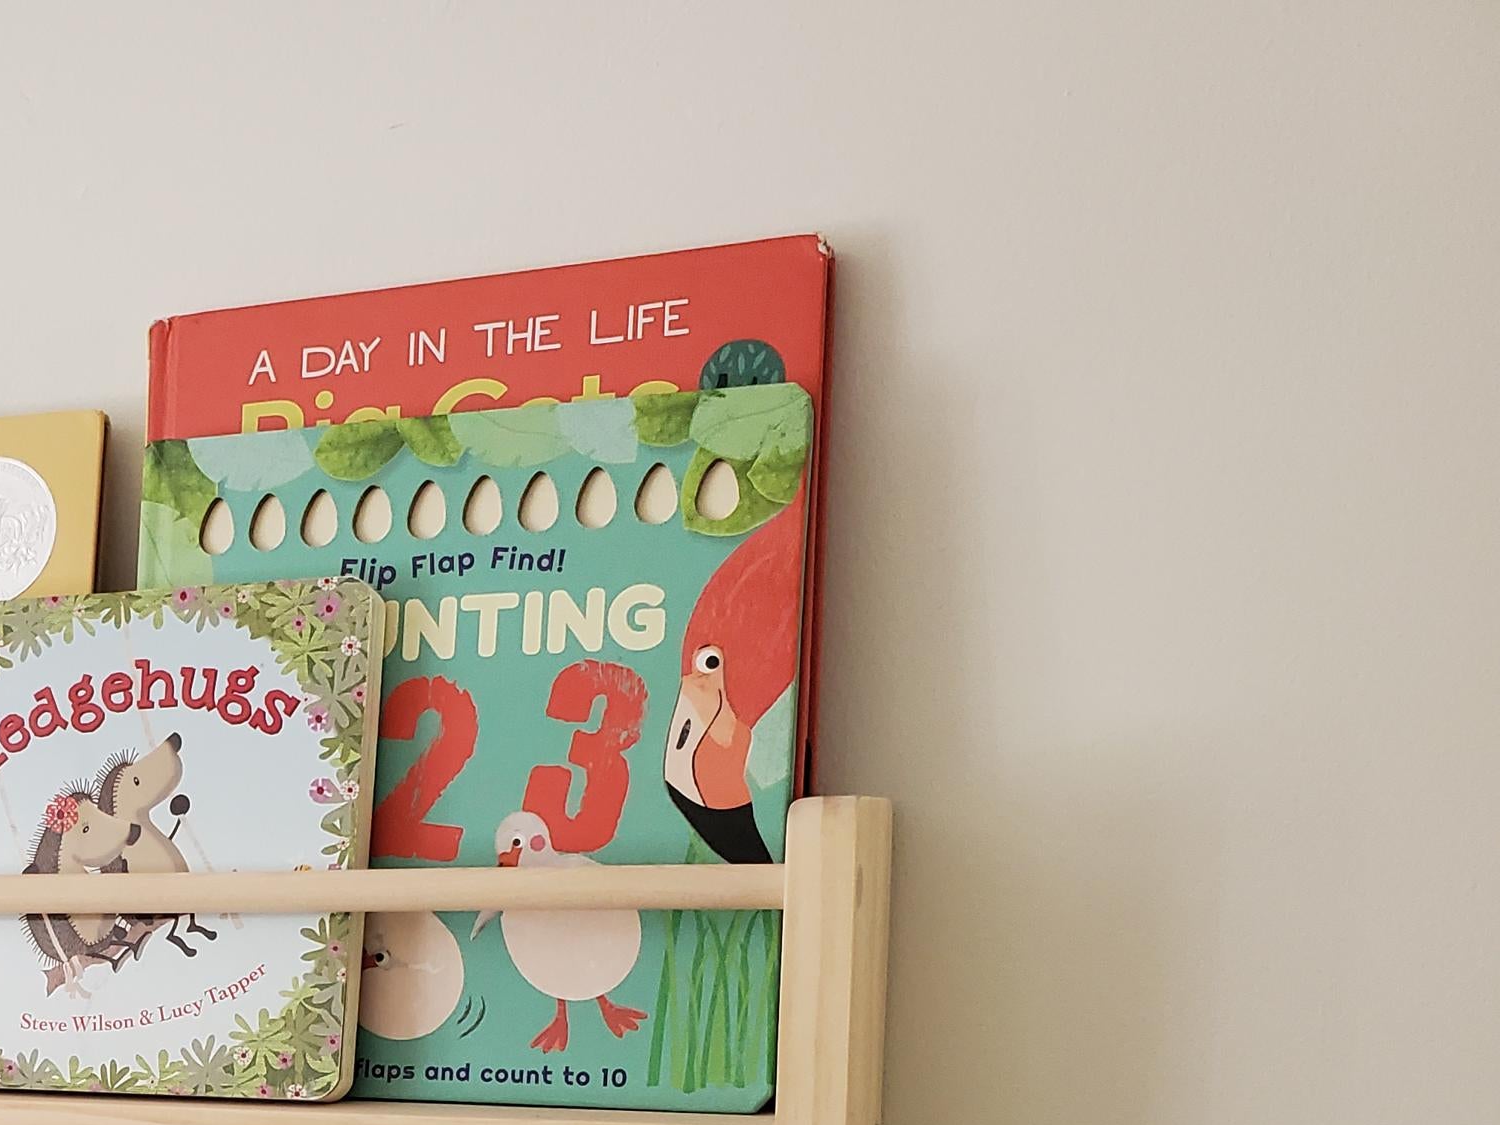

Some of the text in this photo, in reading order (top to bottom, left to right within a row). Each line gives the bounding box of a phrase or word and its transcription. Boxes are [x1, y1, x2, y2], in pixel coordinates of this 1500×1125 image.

[248, 298, 690, 386] A DAY IN THE LIFE
[341, 546, 566, 590] Flip Flap Find!
[384, 584, 666, 661] NTING
[372, 658, 649, 862] 2 3
[20, 962, 267, 1032] Steve Wilson & Lucy Tapper
[355, 1058, 627, 1088] flaps and count to 10
